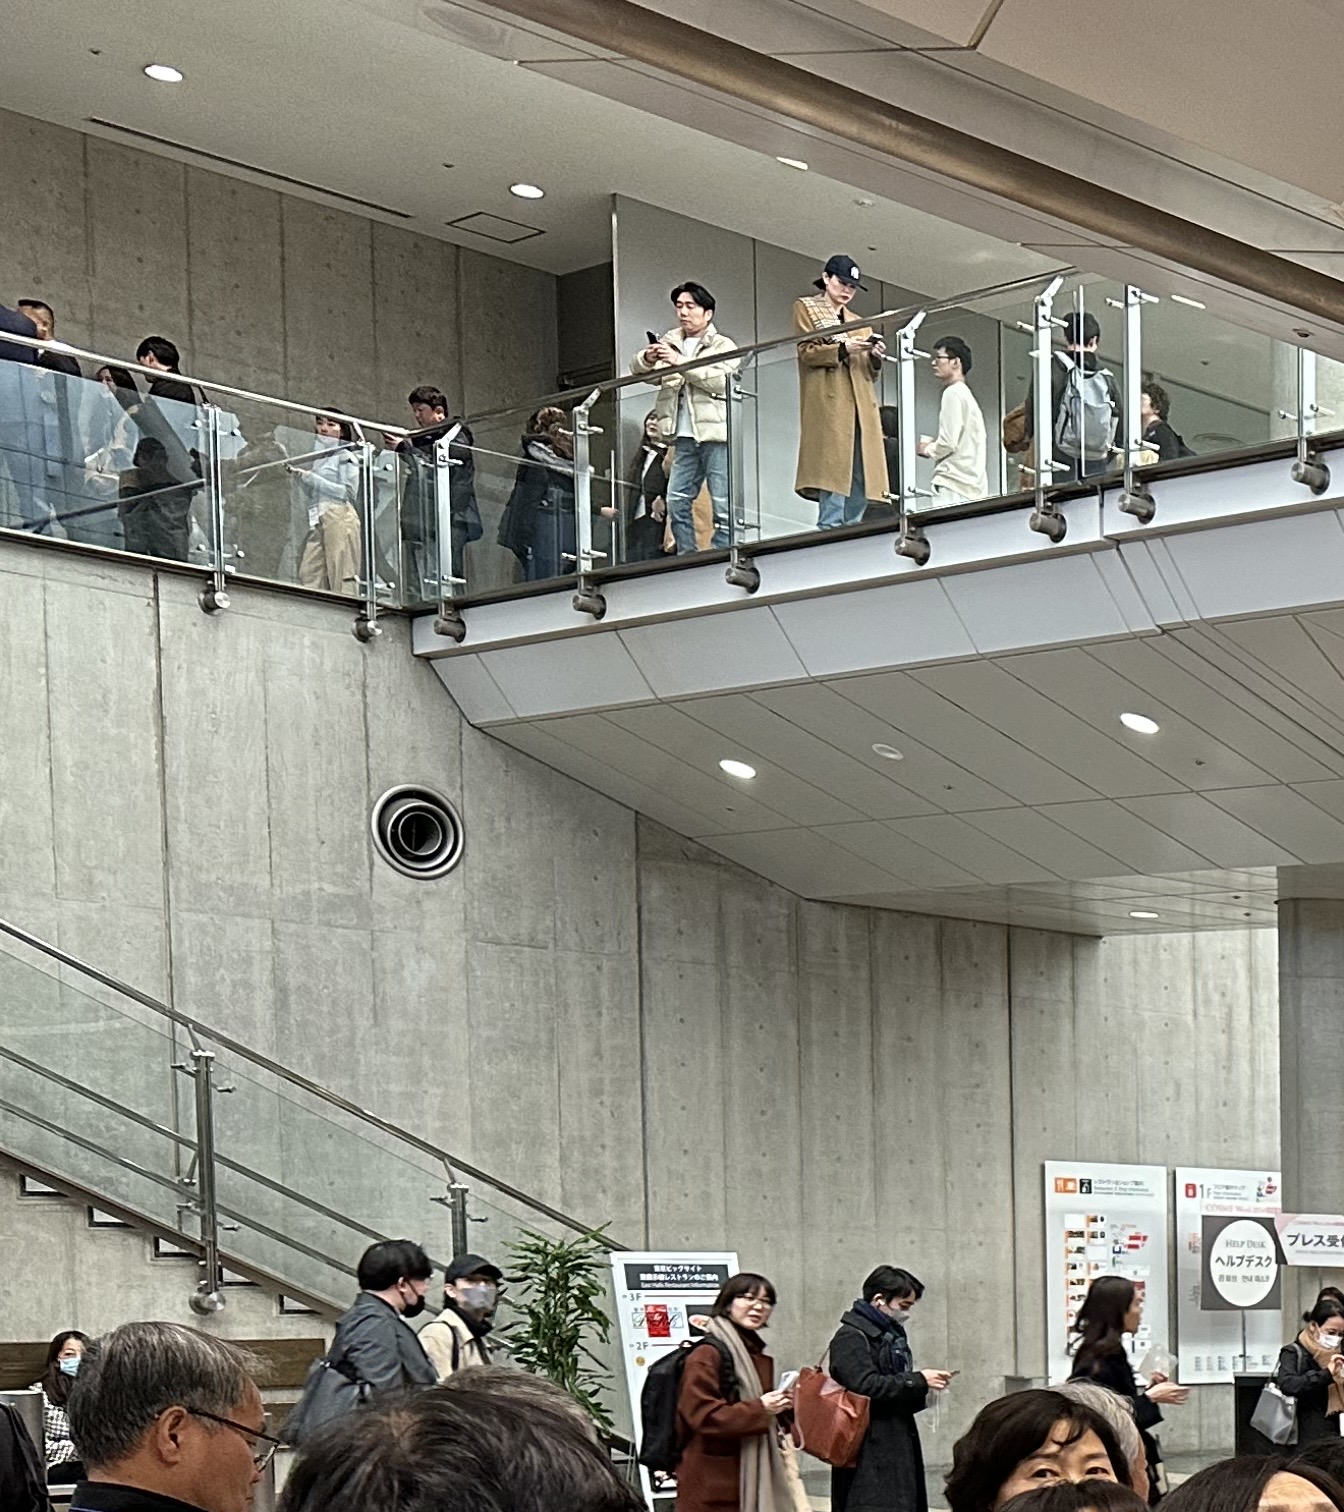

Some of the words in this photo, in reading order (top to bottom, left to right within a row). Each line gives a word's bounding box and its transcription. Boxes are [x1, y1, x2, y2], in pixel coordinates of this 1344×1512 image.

[1215, 1255, 1272, 1268] ヘルプデスク
[629, 1293, 642, 1301] 3F
[636, 1342, 649, 1350] 2F
